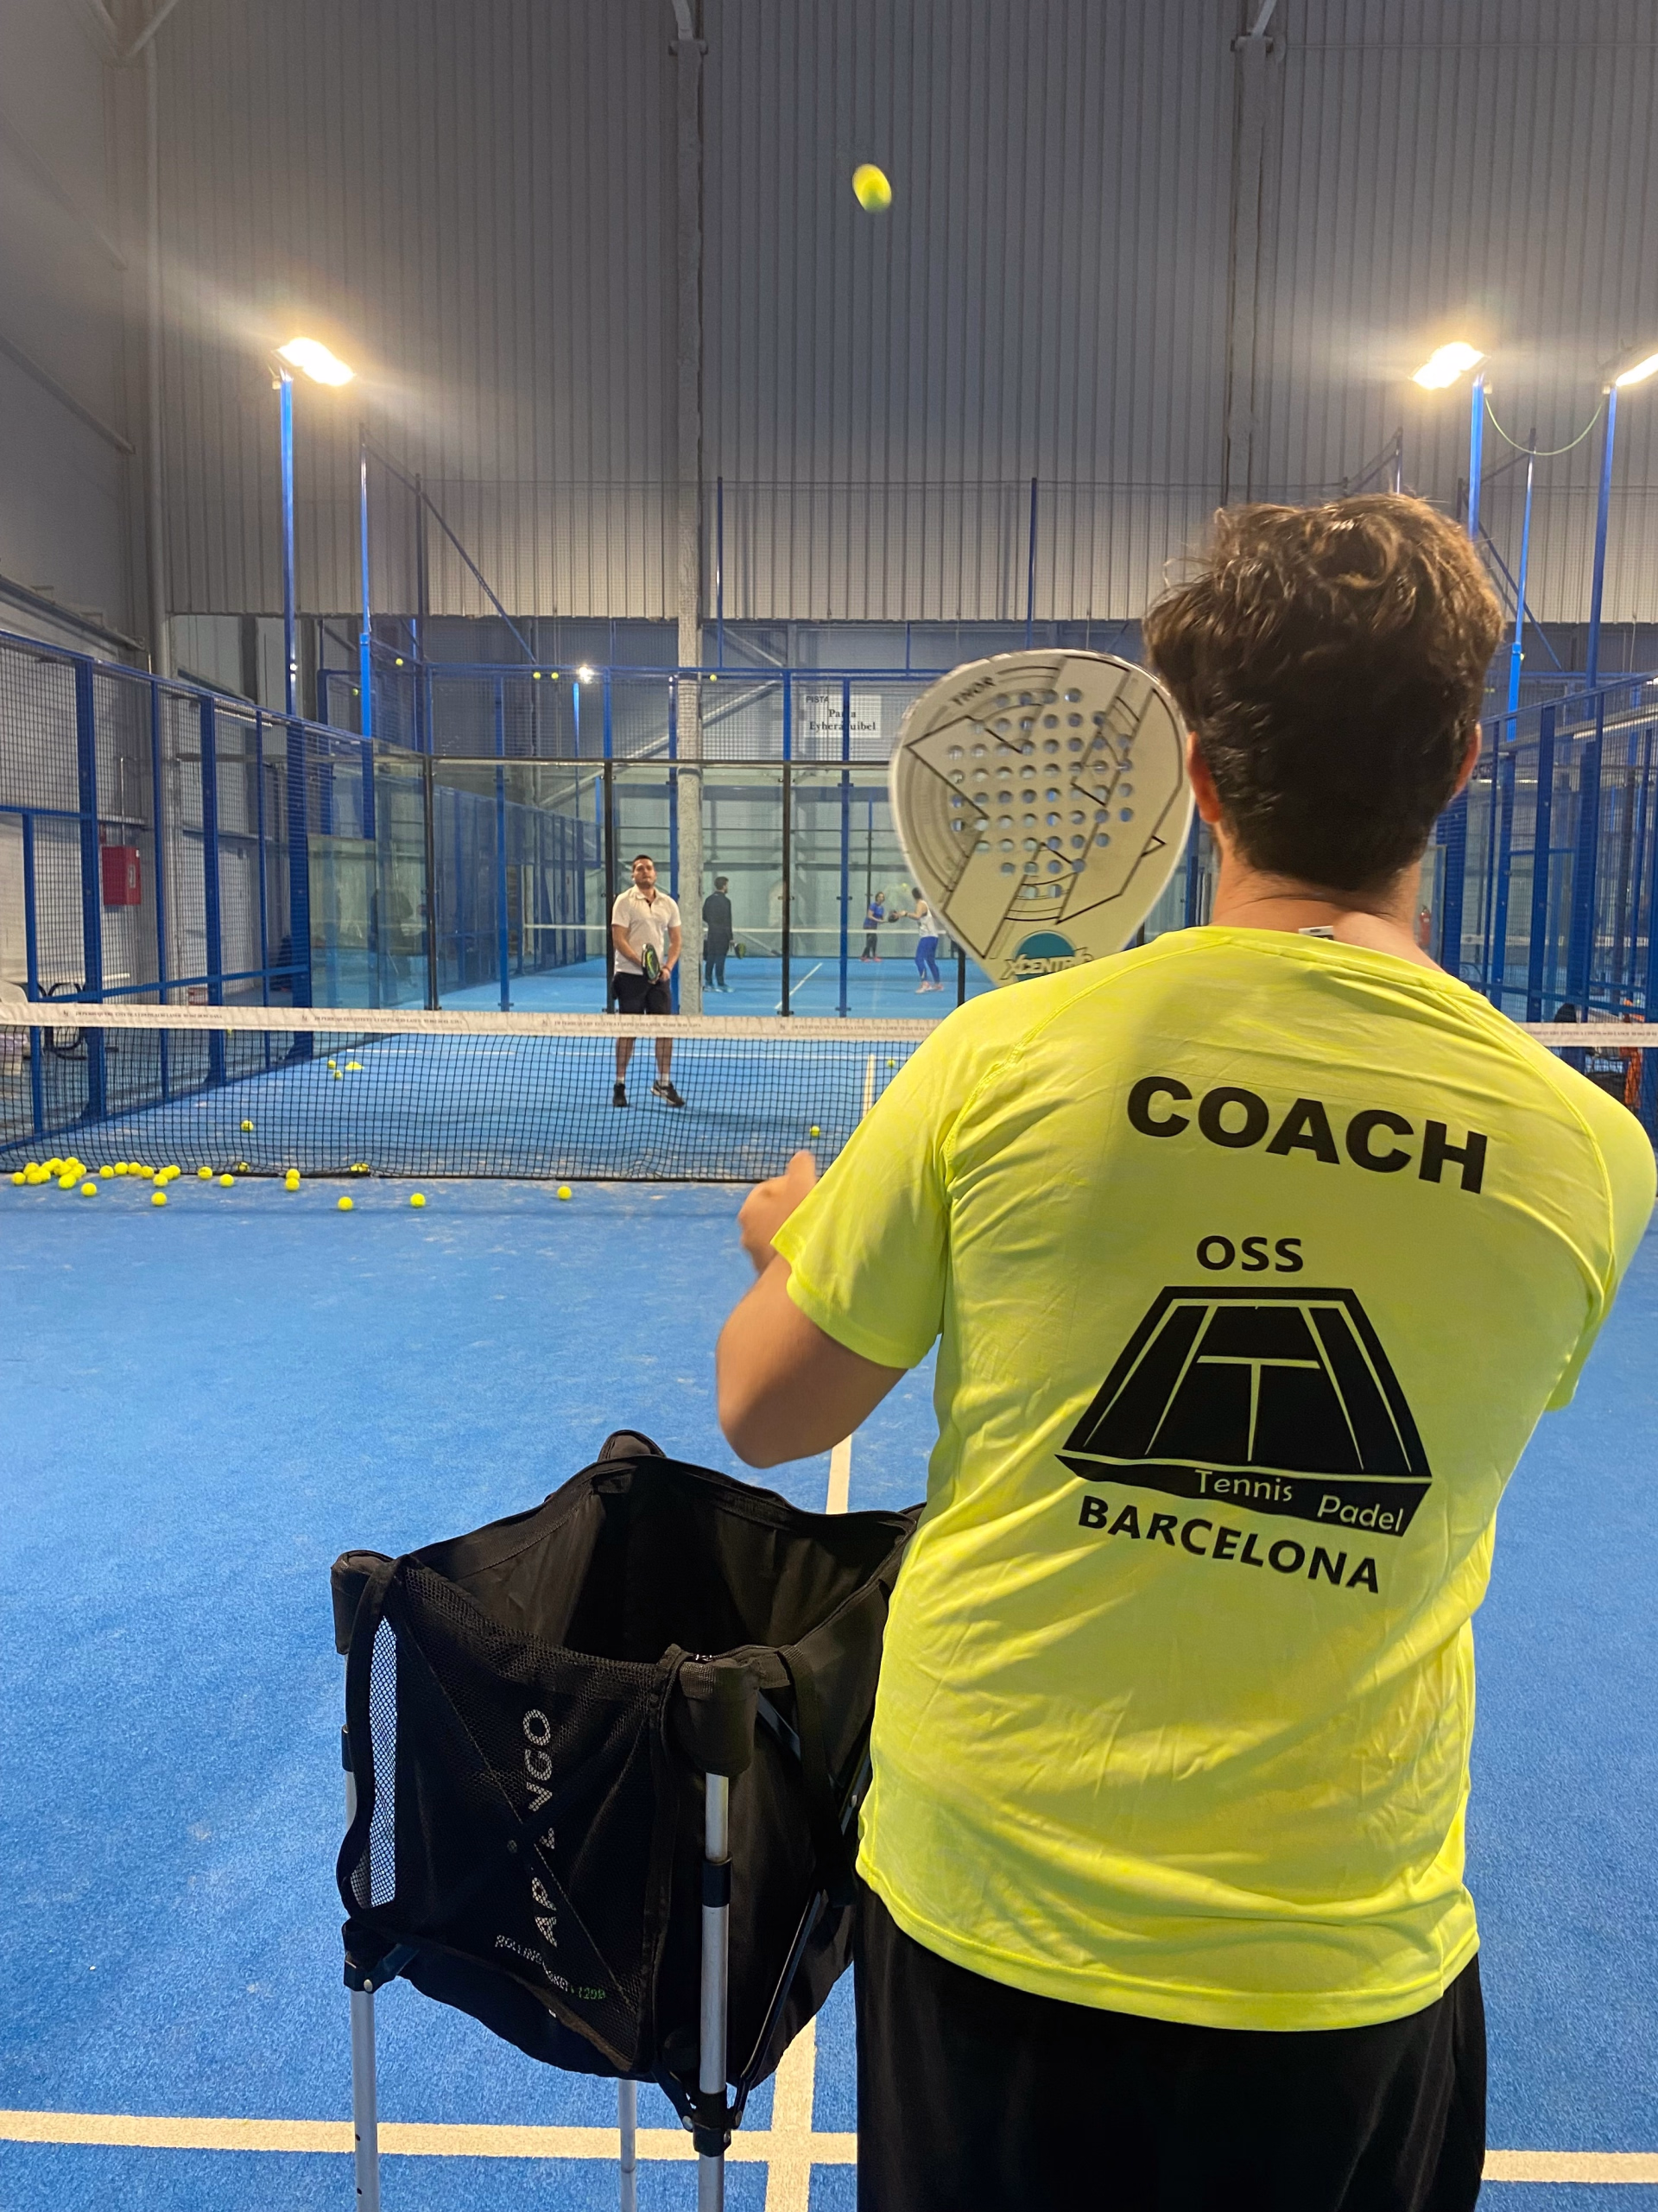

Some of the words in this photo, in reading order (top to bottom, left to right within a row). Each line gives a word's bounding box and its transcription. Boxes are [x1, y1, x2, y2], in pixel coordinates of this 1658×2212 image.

[829, 709, 857, 718] Paa
[1127, 1076, 1488, 1195] COACH
[1196, 1235, 1304, 1272] OSS
[1193, 1469, 1293, 1503] Tennis
[1317, 1495, 1404, 1533] Padel
[1078, 1495, 1380, 1594] BARCELONA
